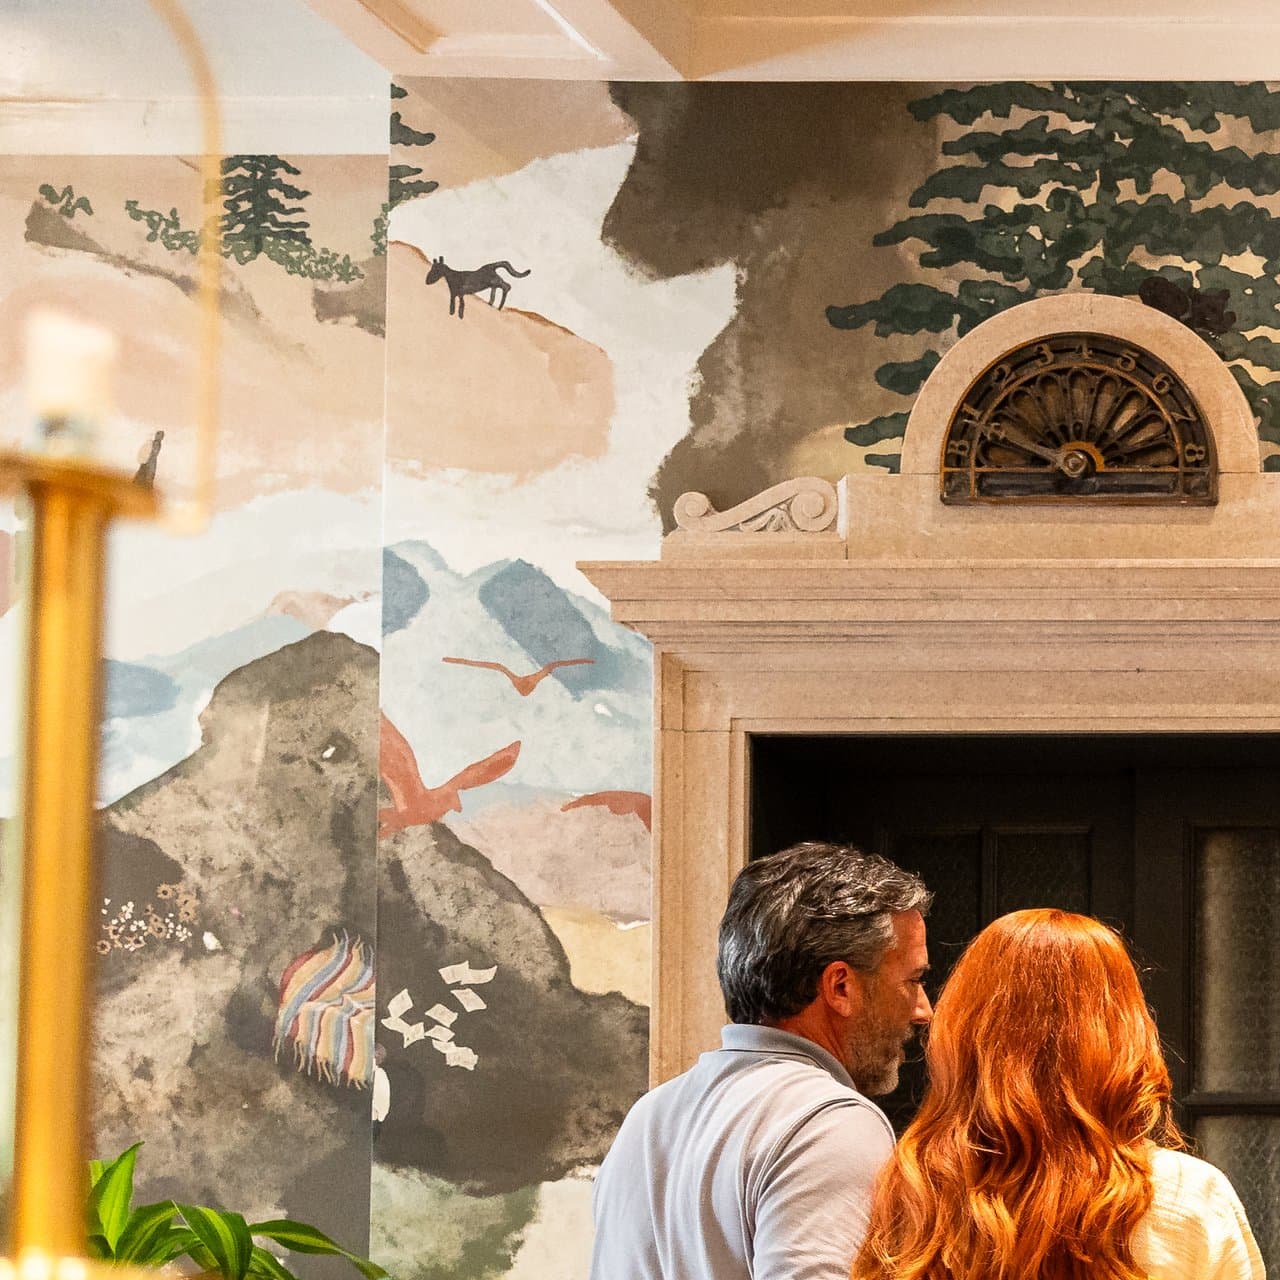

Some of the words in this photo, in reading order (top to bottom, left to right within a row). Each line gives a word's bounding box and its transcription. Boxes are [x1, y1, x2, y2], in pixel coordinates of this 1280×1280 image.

[1034, 343, 1055, 366] 3
[1118, 351, 1140, 372] 5
[1152, 372, 1174, 394] 6
[1173, 403, 1197, 422] 7
